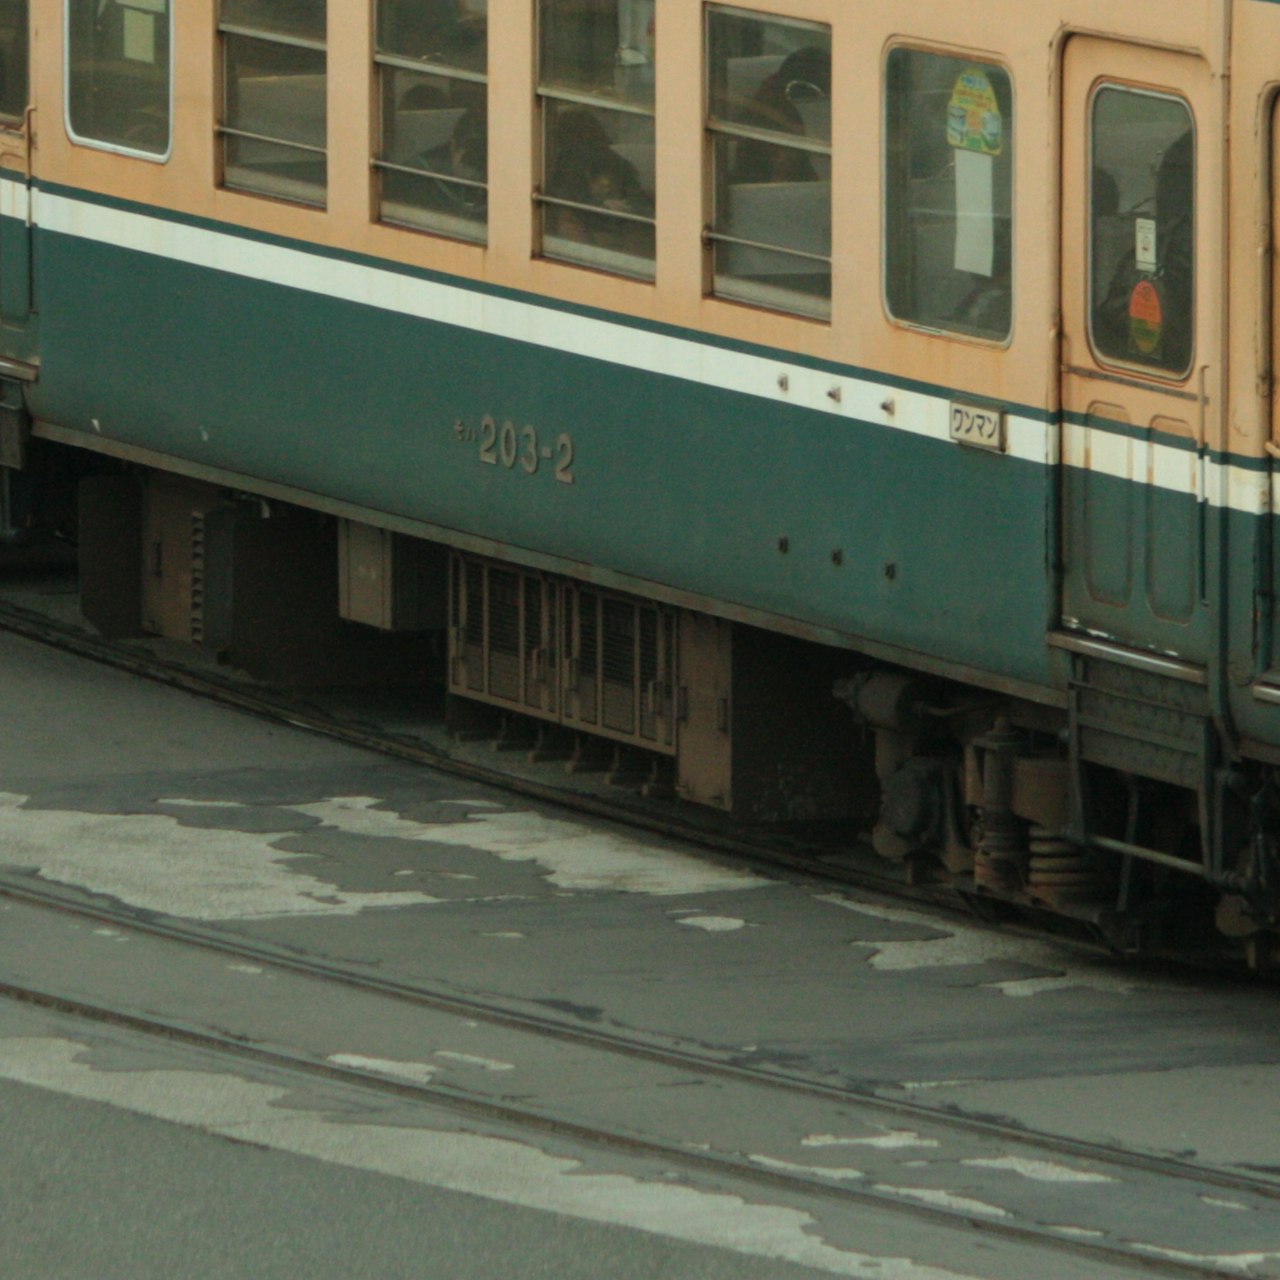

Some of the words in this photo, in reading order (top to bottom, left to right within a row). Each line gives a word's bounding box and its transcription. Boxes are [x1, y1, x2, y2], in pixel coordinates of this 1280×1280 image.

[480, 414, 573, 484] 203-2
[953, 409, 998, 439] ワンマン
